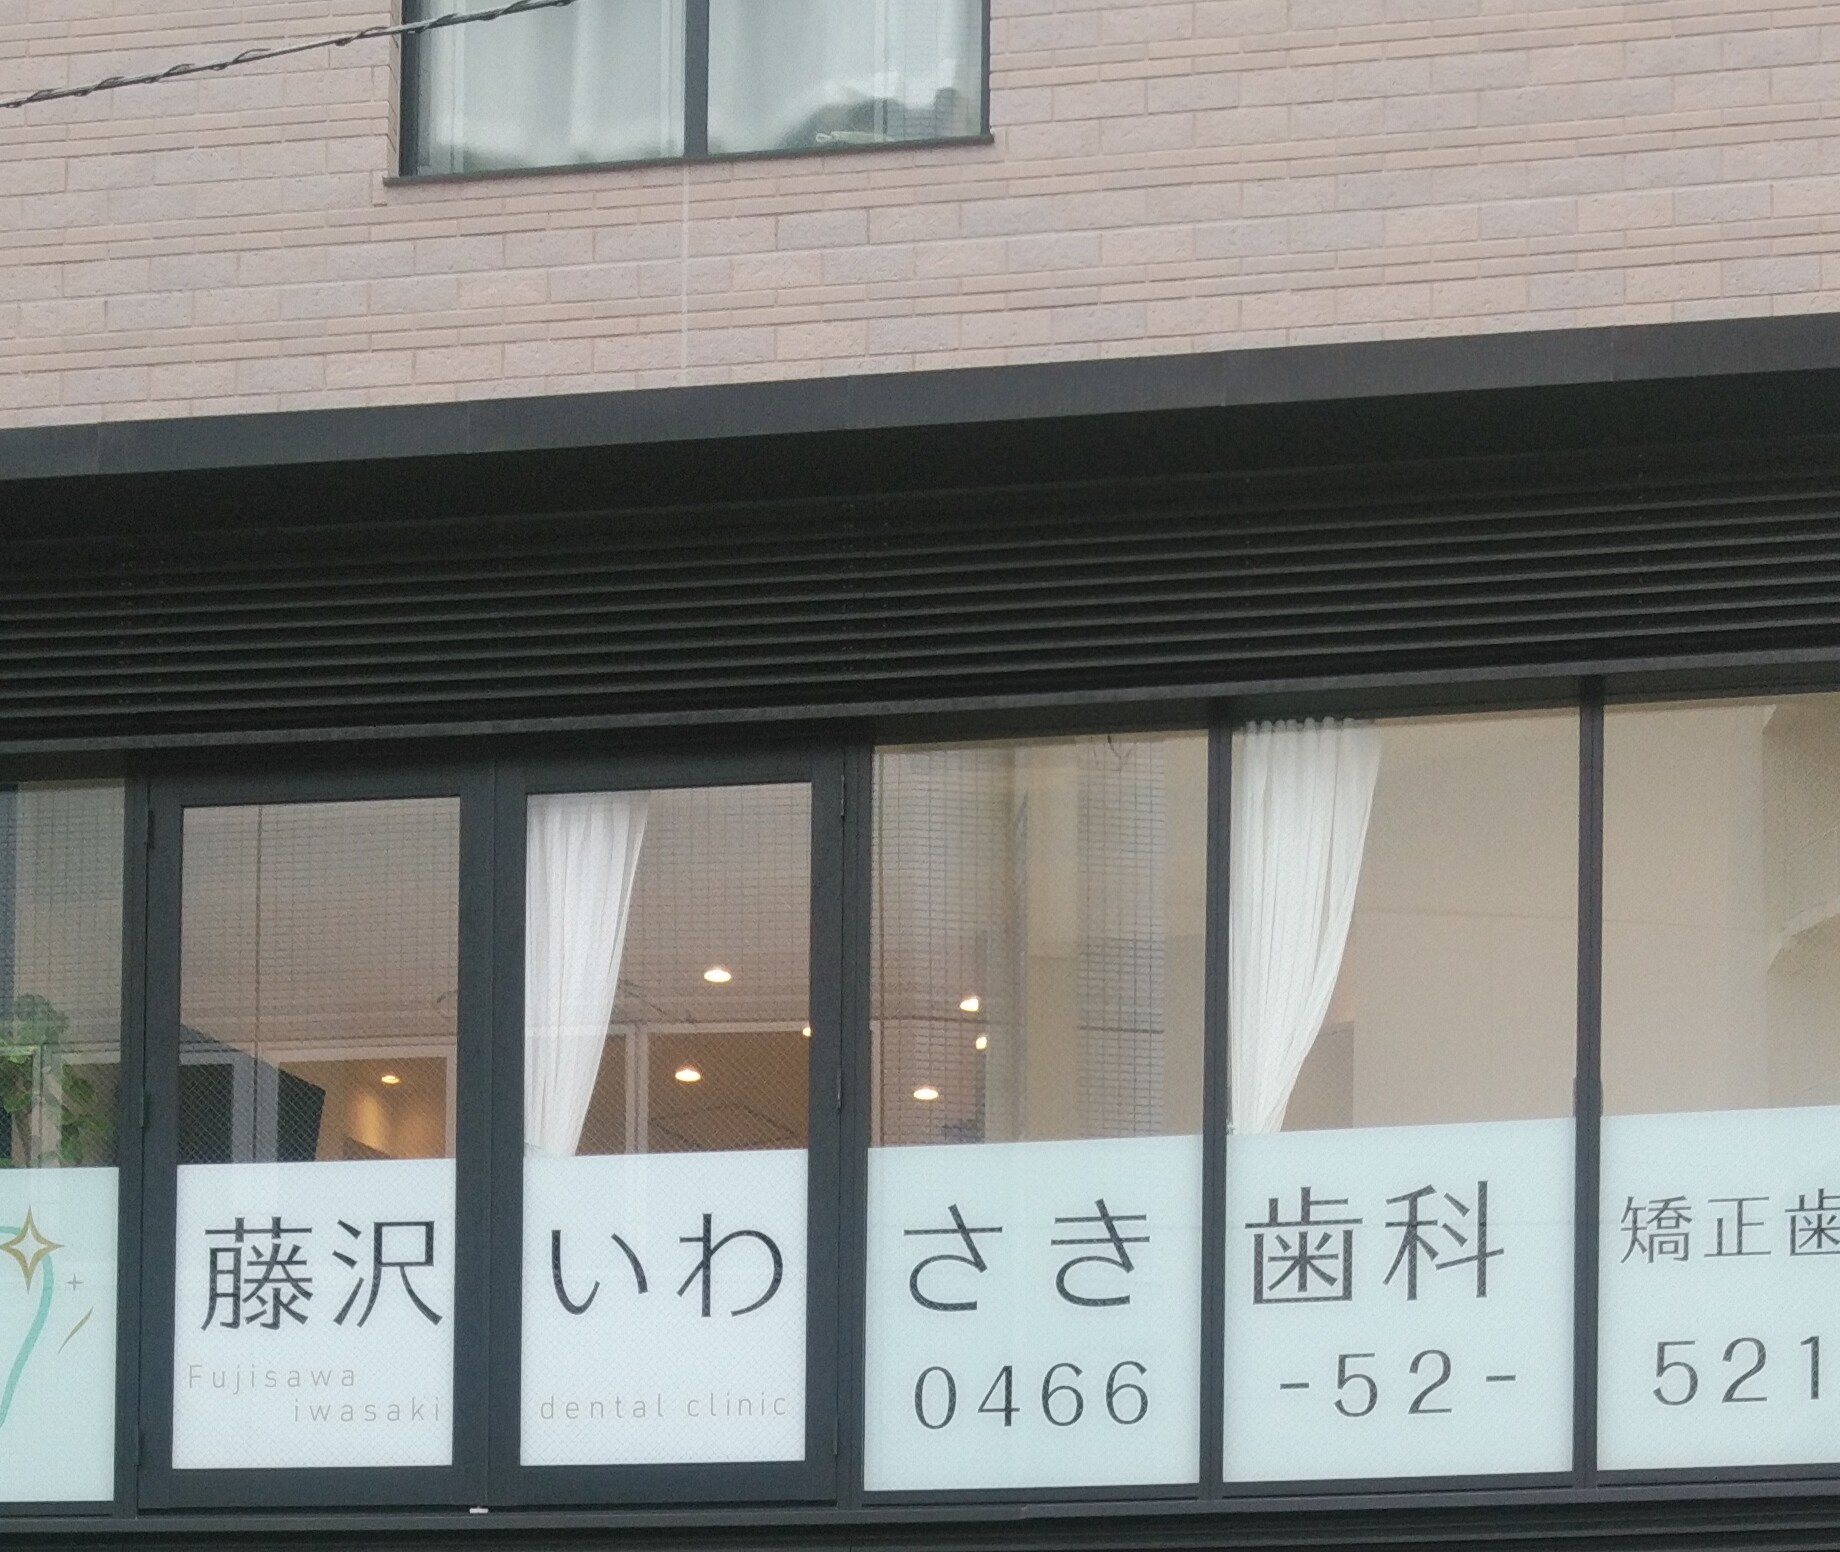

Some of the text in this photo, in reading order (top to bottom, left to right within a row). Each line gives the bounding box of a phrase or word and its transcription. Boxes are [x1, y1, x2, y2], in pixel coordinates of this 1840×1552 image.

[201, 1180, 1505, 1331] 藤沢 いわ さき 歯科
[187, 1363, 357, 1396] Fujisawa
[914, 1360, 1150, 1430] 0466
[291, 1395, 444, 1424] iwasaki
[539, 1392, 787, 1421] dental clinic
